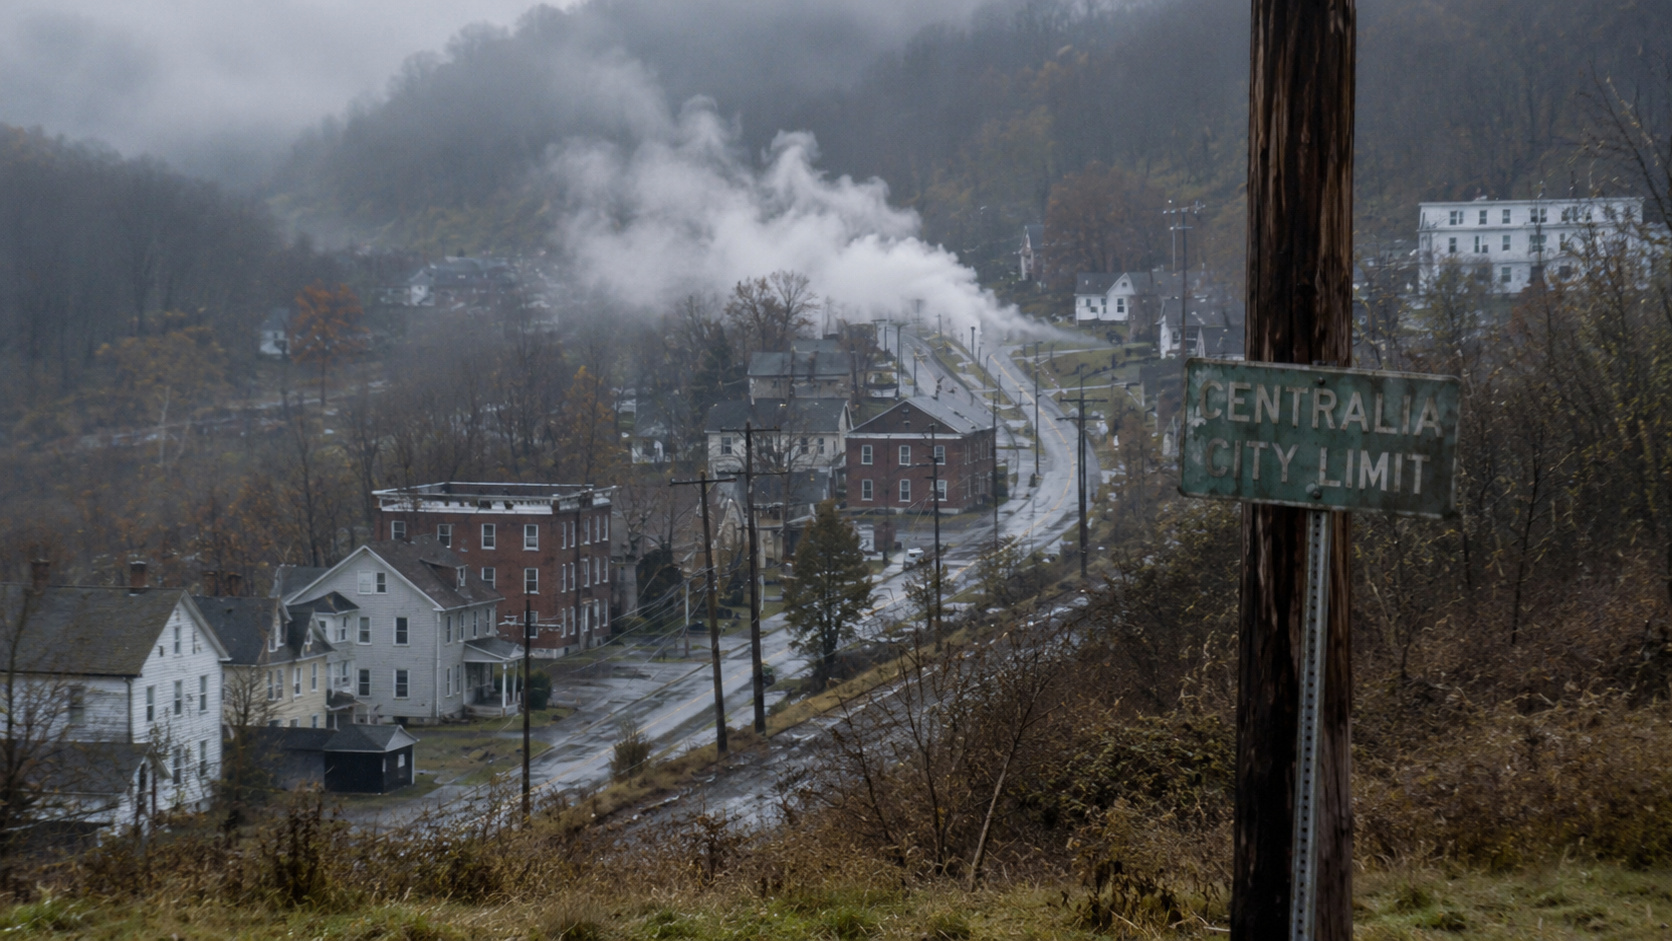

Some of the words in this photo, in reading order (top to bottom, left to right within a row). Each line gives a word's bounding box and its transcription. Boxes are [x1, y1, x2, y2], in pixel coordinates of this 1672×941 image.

[1200, 380, 1443, 438] CENTRALIA
[1206, 437, 1299, 483] CITY
[1319, 447, 1431, 494] LIMIT
